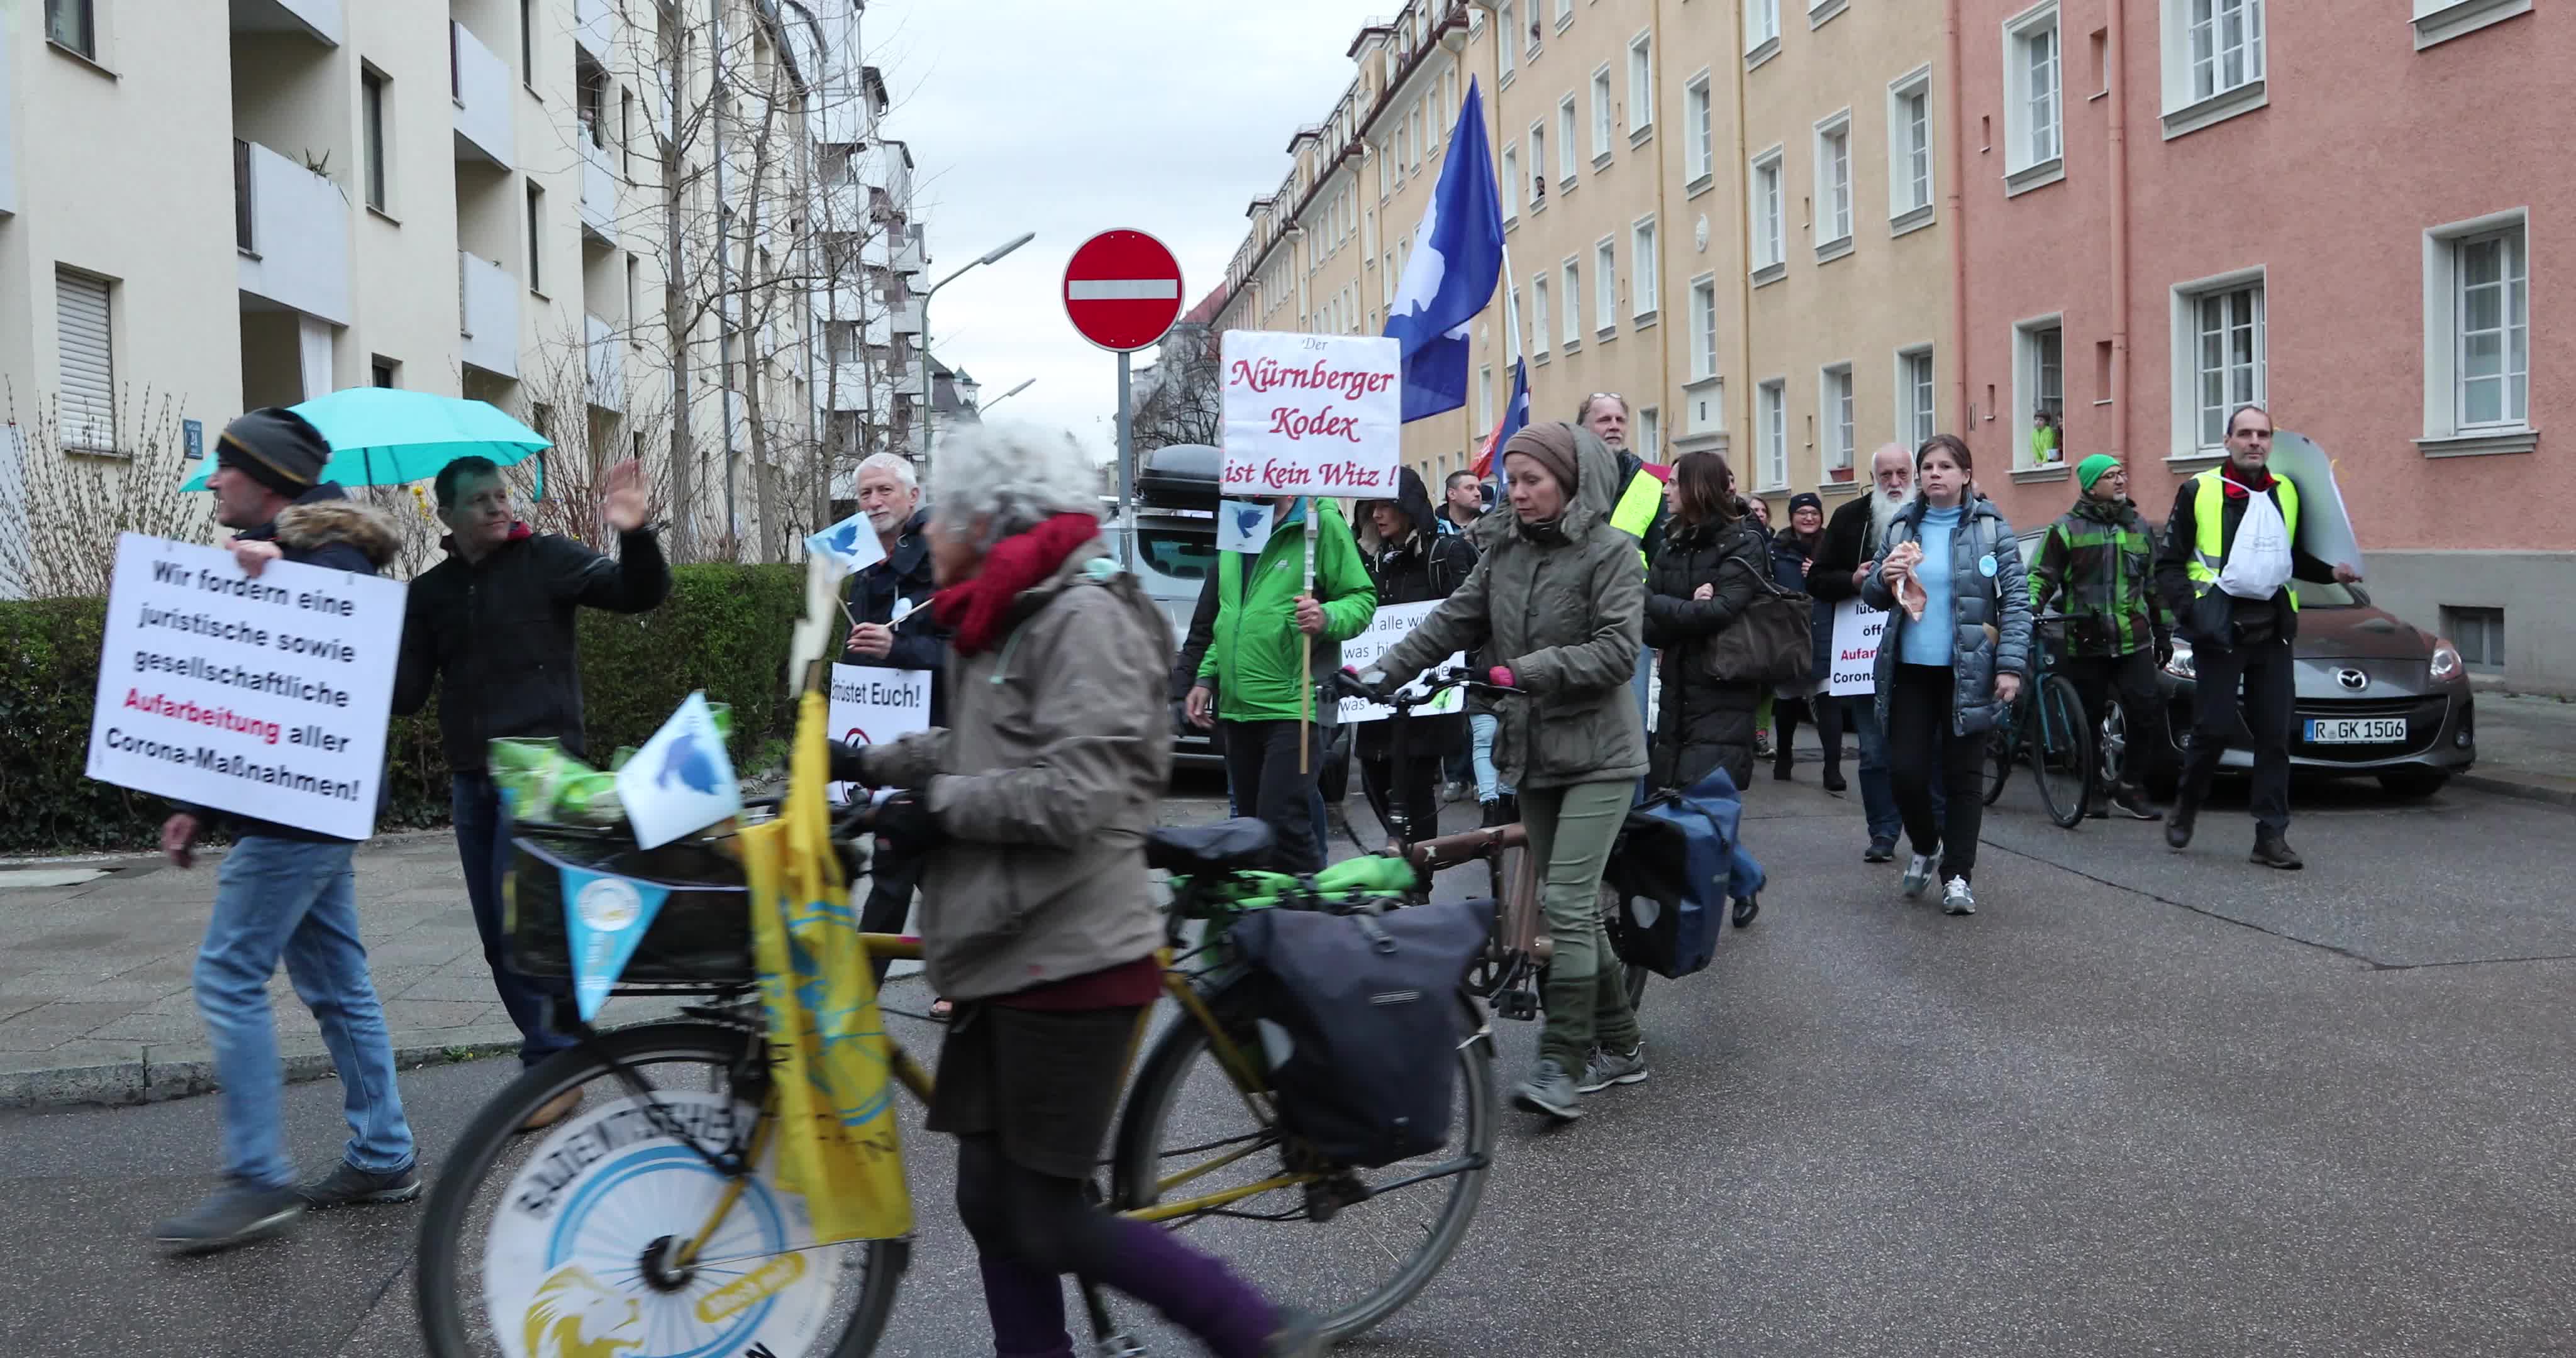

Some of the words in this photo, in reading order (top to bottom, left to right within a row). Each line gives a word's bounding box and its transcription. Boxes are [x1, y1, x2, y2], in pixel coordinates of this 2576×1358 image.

[1302, 337, 1328, 350] Der
[1230, 356, 1394, 400] Nürnberger
[1269, 406, 1361, 442] Kodex
[1225, 459, 1257, 483] ist
[1262, 458, 1311, 489] kein
[1319, 460, 1379, 486] Witz
[152, 559, 191, 587] Wir
[196, 568, 289, 605] fordern
[298, 588, 355, 617] eine
[136, 602, 269, 648] juristische
[275, 632, 356, 663] sowie
[1379, 615, 1403, 631] alle
[1344, 646, 1369, 660] was
[1841, 648, 1879, 661] Aufar
[133, 649, 350, 708] gesellschaftliche
[872, 682, 921, 708] Euch!
[1340, 699, 1365, 712] was
[123, 687, 280, 744] Aufarbeitung
[287, 724, 352, 753] aller
[2316, 722, 2326, 739] R
[2338, 722, 2360, 739] GK
[2364, 721, 2404, 738] 1506
[104, 726, 360, 802] Corona-Maßnahmen!
